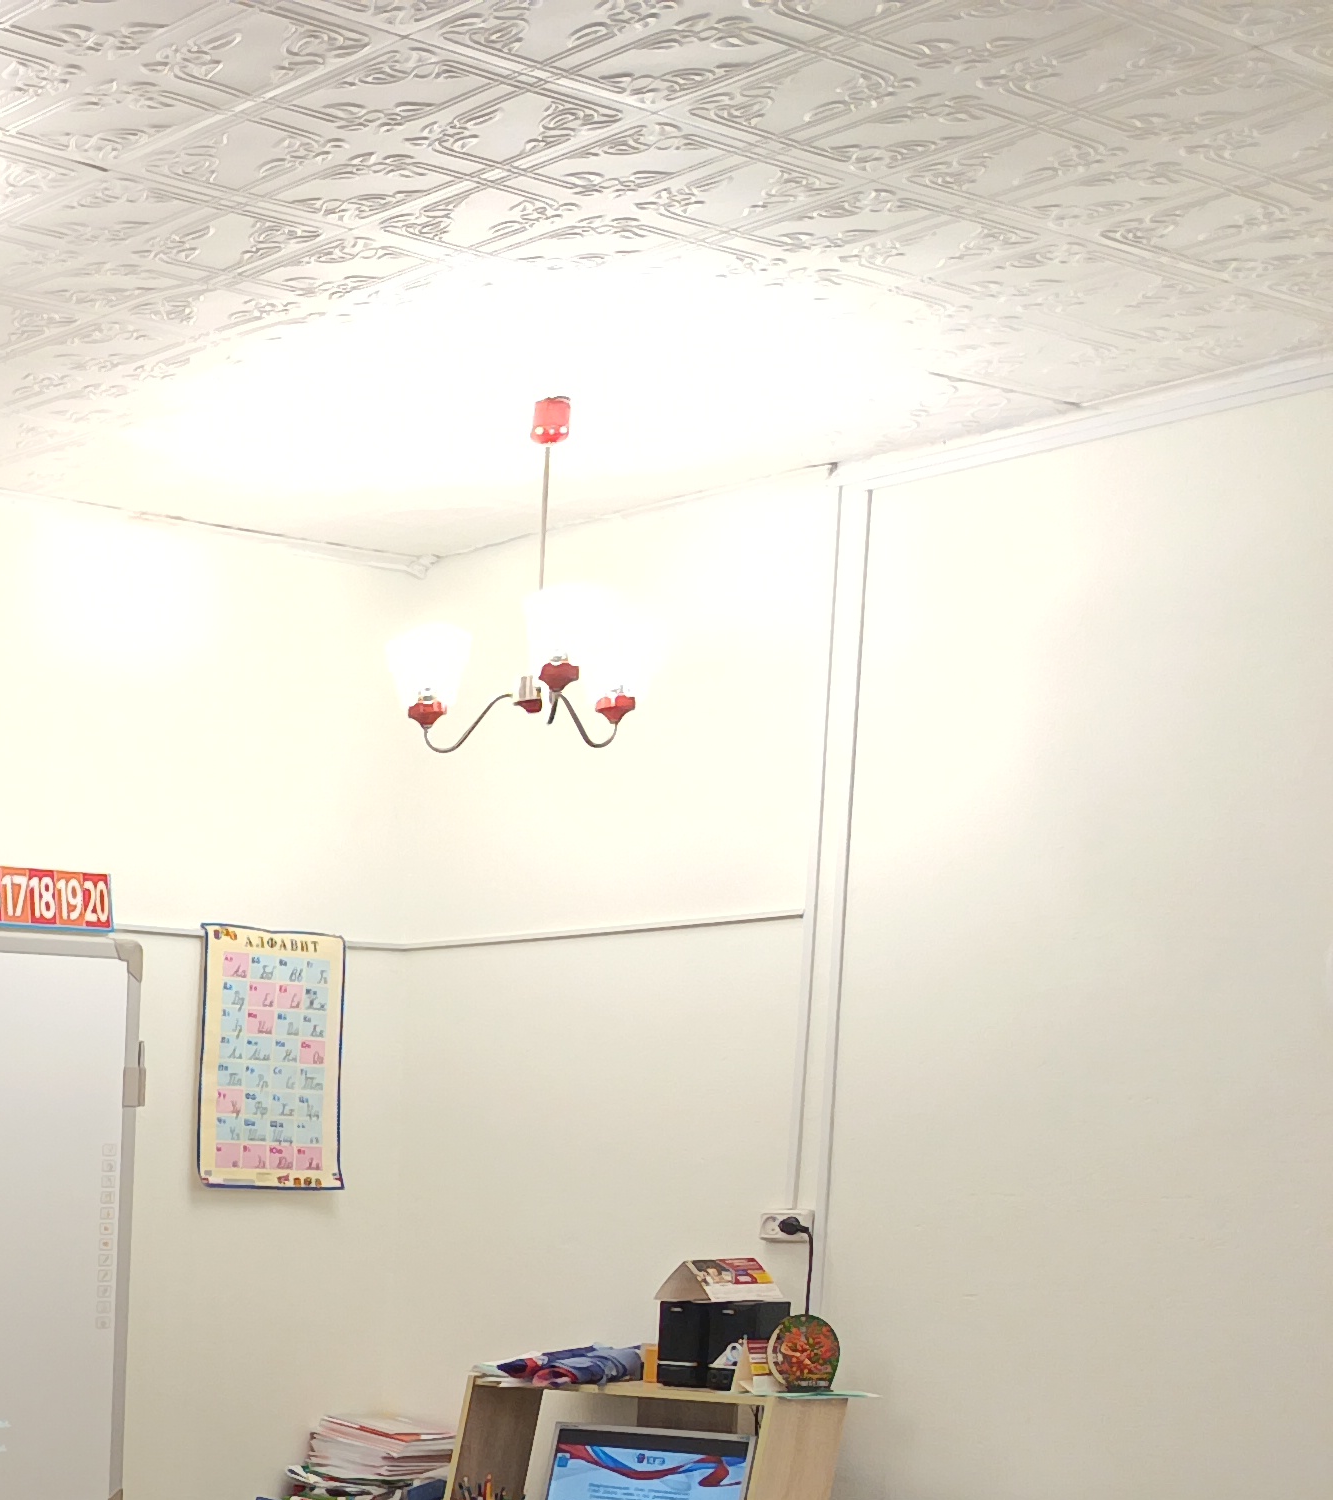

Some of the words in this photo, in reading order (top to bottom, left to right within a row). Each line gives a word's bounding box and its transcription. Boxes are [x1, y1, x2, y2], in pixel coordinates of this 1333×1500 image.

[1, 875, 28, 917] 17
[29, 876, 56, 919] 18
[56, 878, 82, 920] 19
[83, 880, 109, 922] 20
[245, 936, 319, 952] АЛФАВИТ
